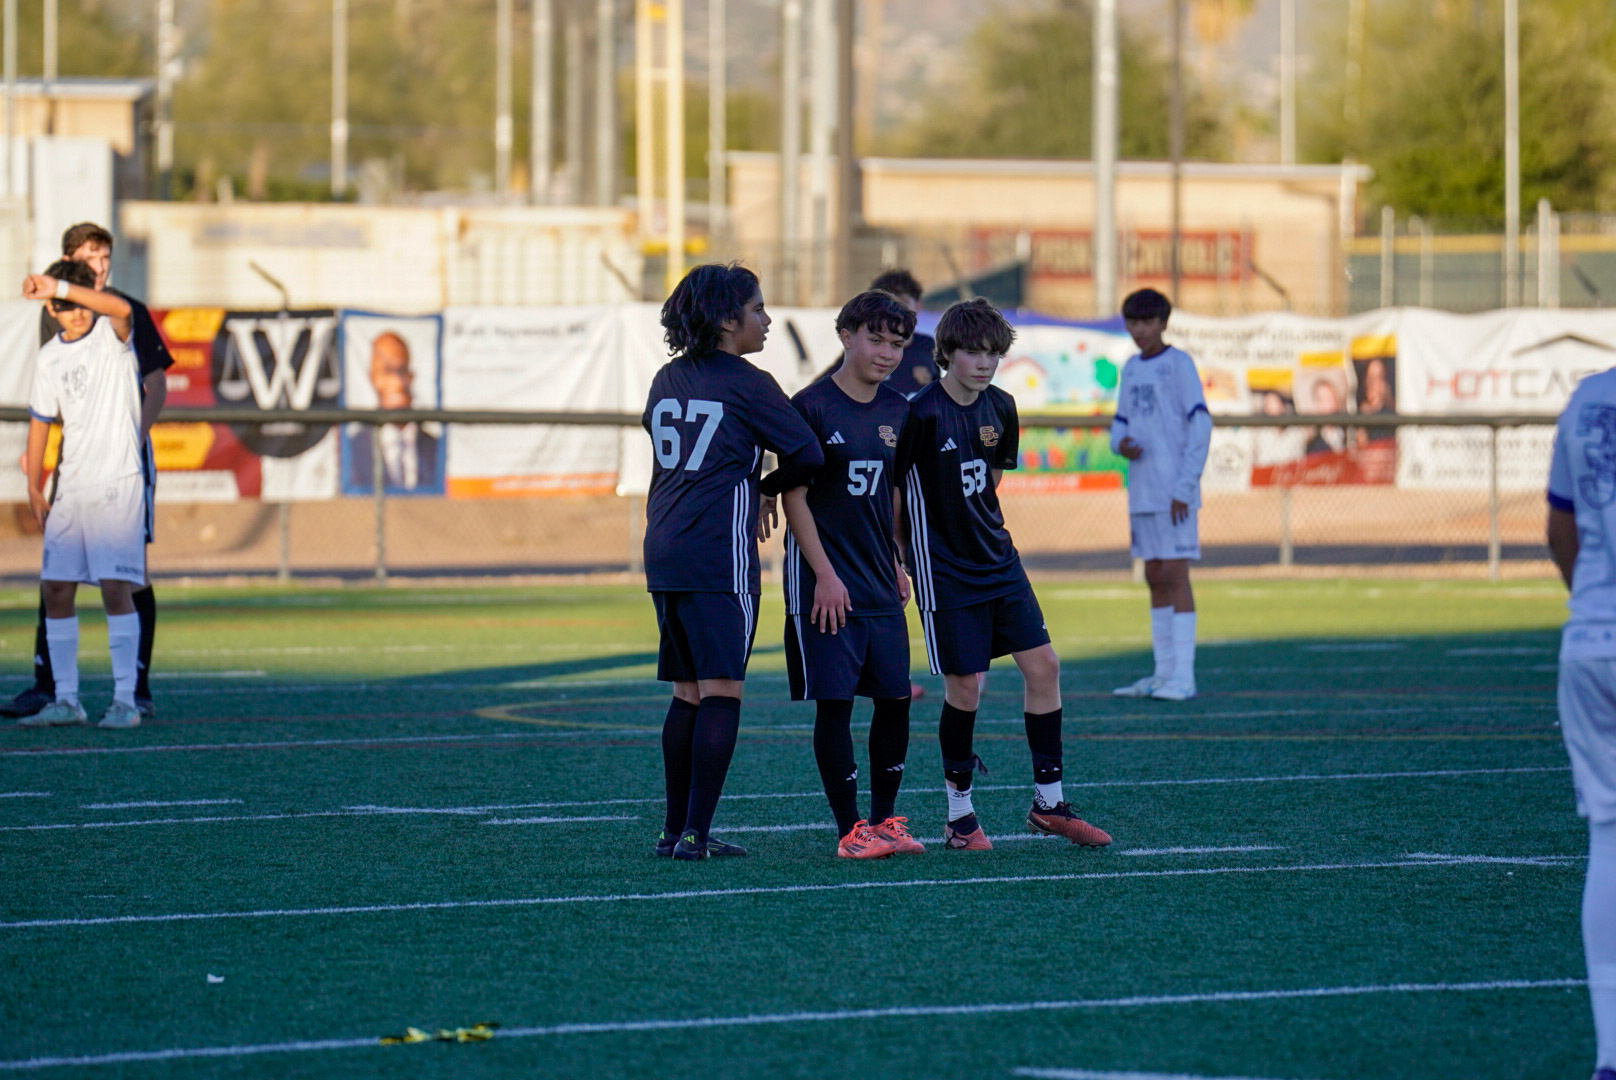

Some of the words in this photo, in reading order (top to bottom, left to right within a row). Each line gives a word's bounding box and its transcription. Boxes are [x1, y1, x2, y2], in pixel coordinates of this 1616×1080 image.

[226, 316, 335, 410] W
[651, 398, 723, 471] 67
[979, 425, 999, 447] SC
[847, 460, 884, 496] 57
[960, 458, 987, 497] 58
